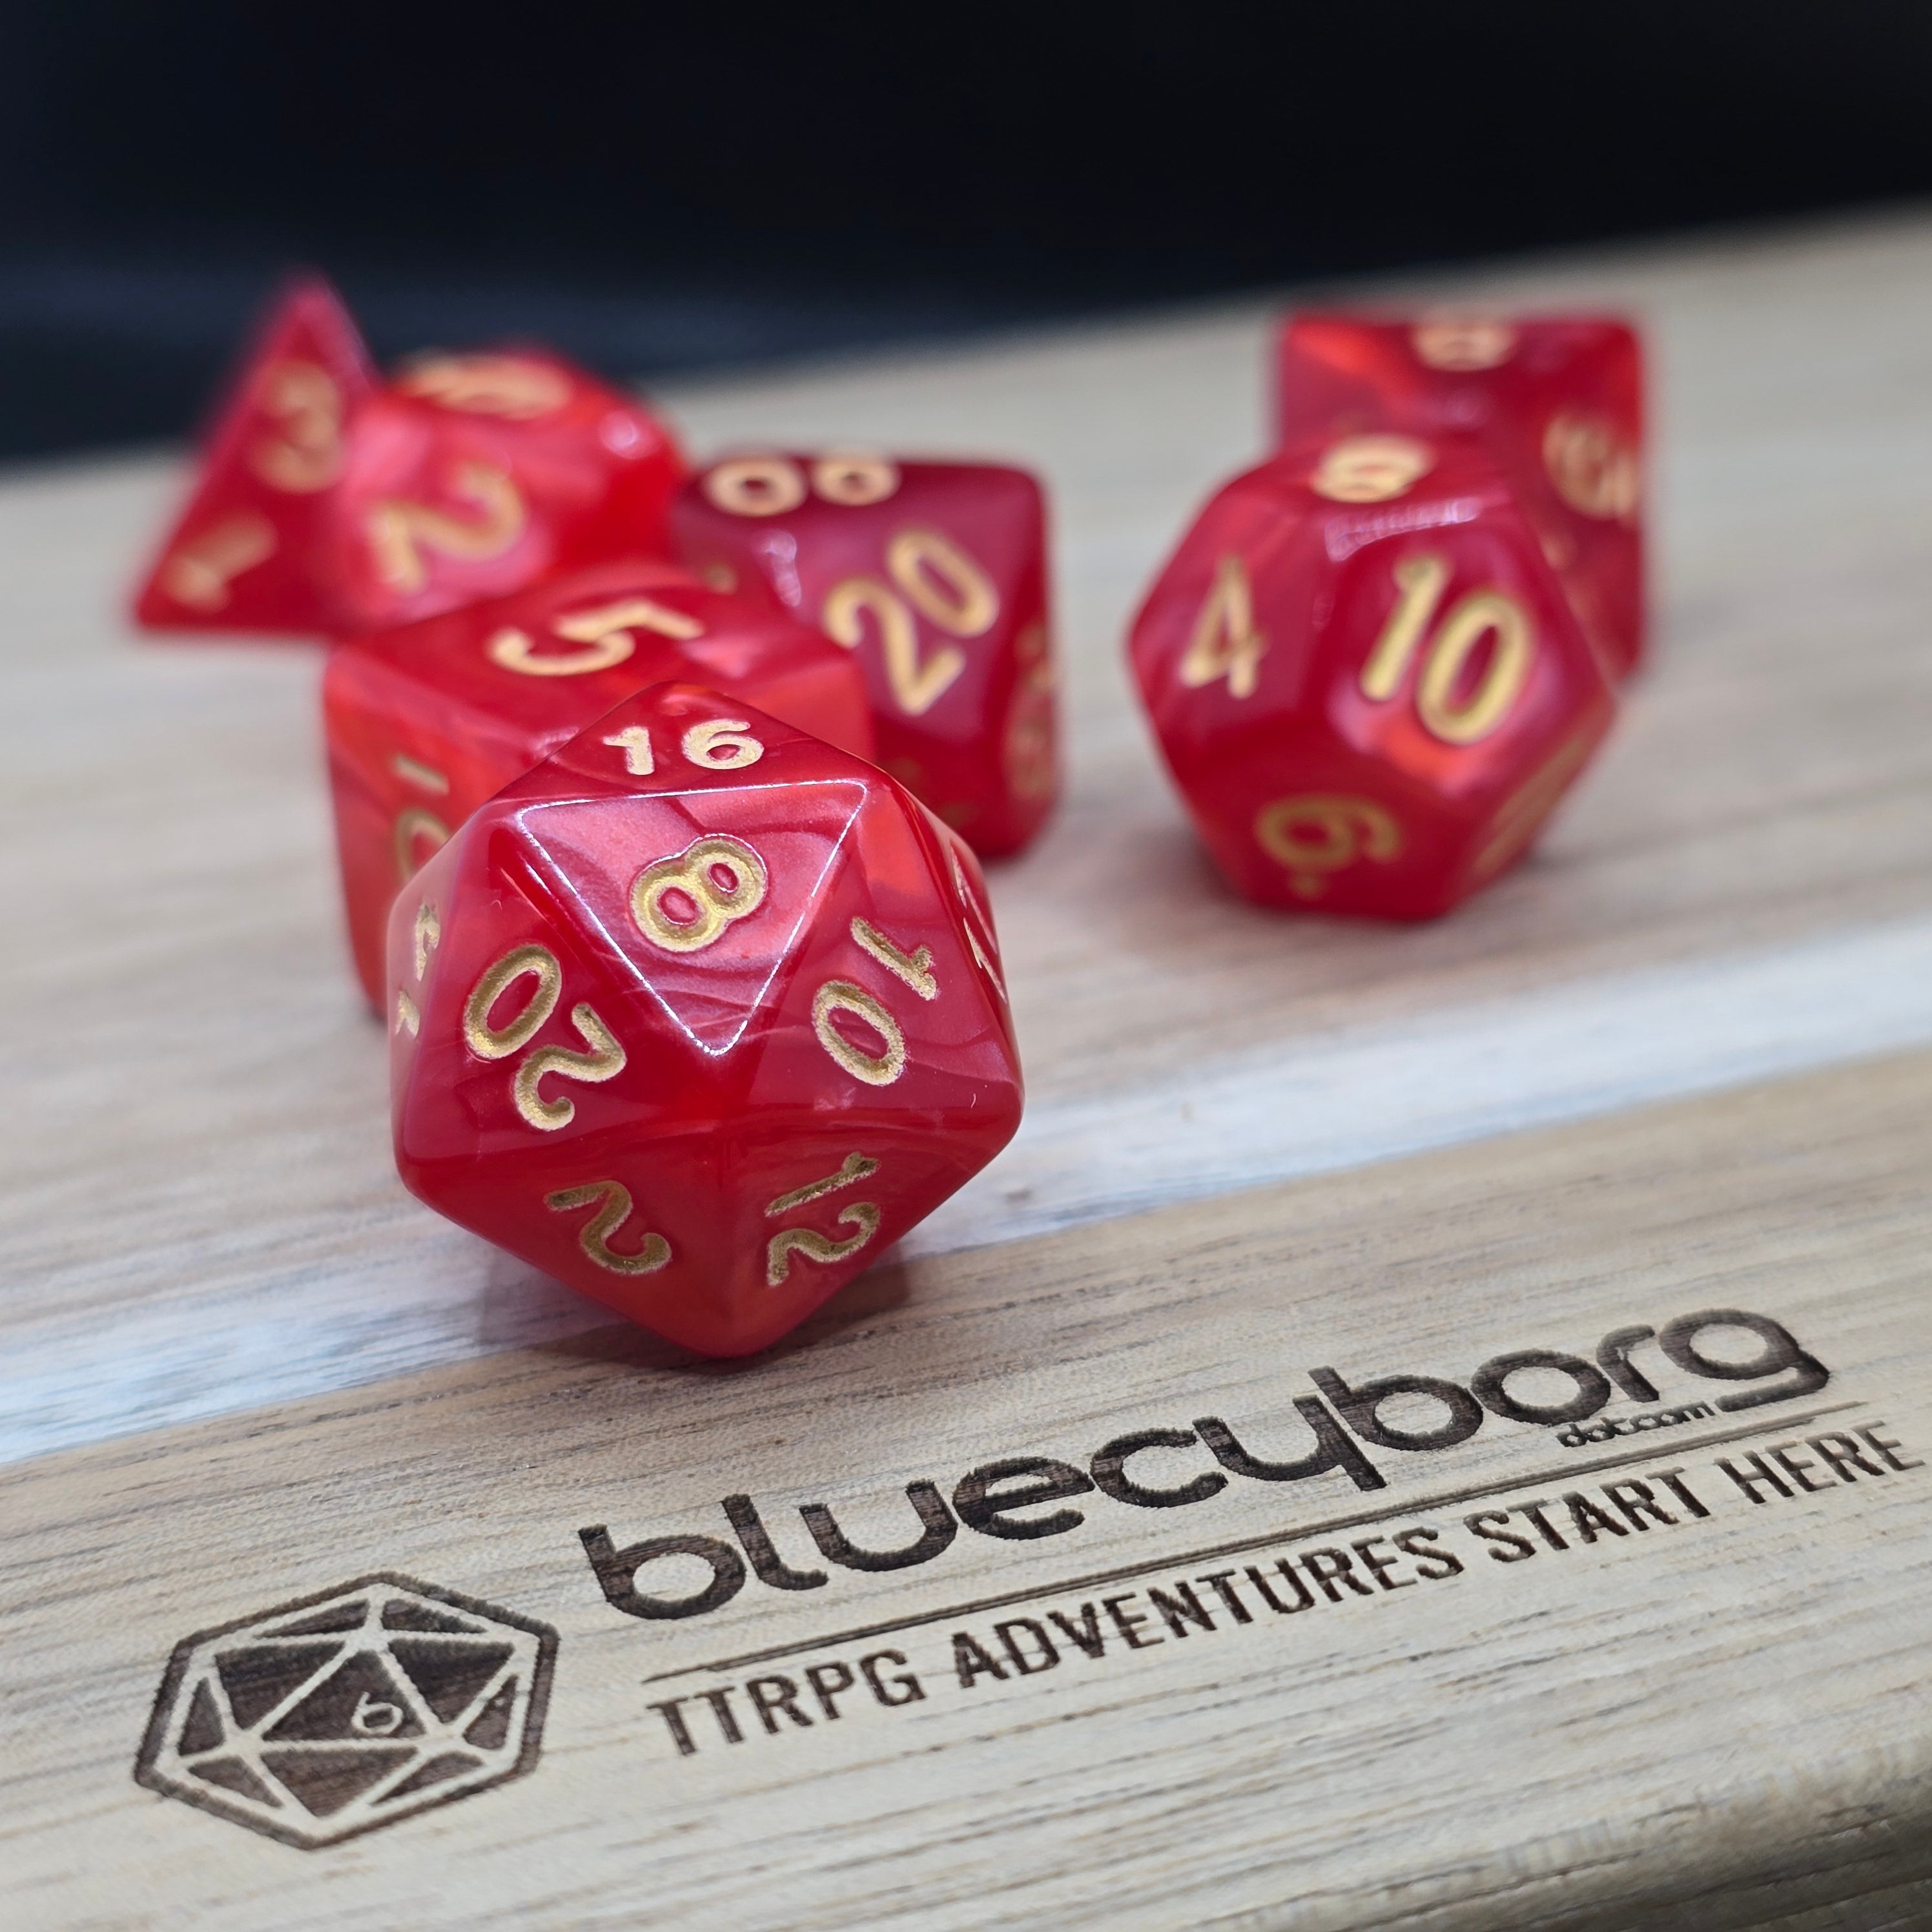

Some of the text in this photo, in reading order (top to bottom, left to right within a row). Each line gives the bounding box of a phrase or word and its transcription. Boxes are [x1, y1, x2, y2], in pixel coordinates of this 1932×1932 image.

[260, 358, 344, 492] 3
[369, 462, 524, 599] 2
[489, 599, 705, 675] 5
[821, 524, 1000, 715] 20
[1178, 554, 1267, 699] 4
[1360, 555, 1533, 745] 10
[602, 718, 766, 776] 16
[630, 834, 768, 953] 8
[464, 942, 628, 1131] 20
[811, 917, 939, 1087] 10
[544, 1179, 673, 1276] 2
[764, 1151, 881, 1287] 12
[578, 1308, 1831, 1621] bluecyborg
[646, 1418, 1926, 1757] TTRPG ADVENTURES START HERE
[352, 1689, 404, 1737] 6
